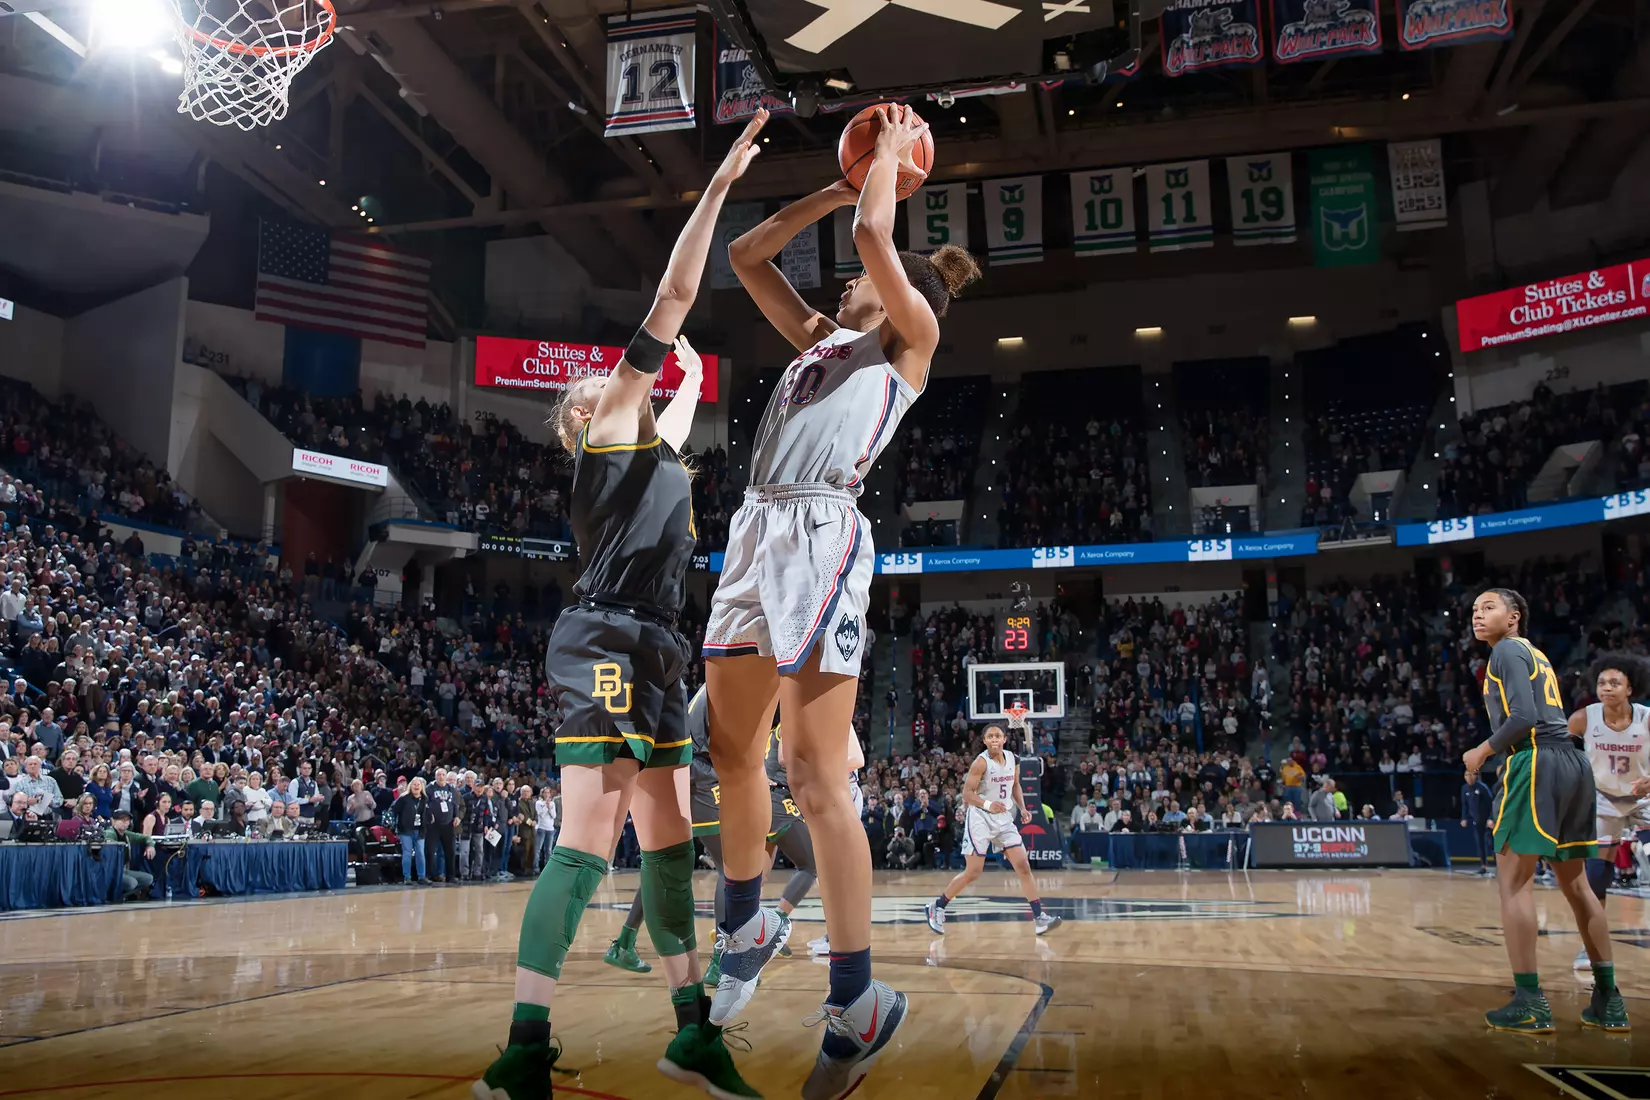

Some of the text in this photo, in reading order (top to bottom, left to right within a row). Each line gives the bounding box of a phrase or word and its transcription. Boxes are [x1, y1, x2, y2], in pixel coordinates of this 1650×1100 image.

[1326, 22, 1371, 46] PACK
[621, 59, 681, 105] 12
[1084, 198, 1124, 232] 10
[1161, 191, 1198, 226] 11
[1241, 187, 1286, 224] 19
[926, 214, 950, 246] 5
[1002, 207, 1025, 242] 9
[1524, 271, 1606, 303] Suites &
[1509, 289, 1627, 325] Club Tickets
[1481, 305, 1647, 347] PremiumSeating@XLCenter.com
[537, 341, 604, 362] Suites &
[522, 357, 560, 376] Club
[302, 453, 334, 466] RICOH
[350, 463, 380, 476] RICOH
[1507, 514, 1543, 527] Company
[552, 543, 562, 554] 0
[1104, 549, 1134, 560] Company
[1263, 541, 1295, 551] Company
[692, 555, 708, 564] 7:03
[694, 562, 706, 570] PM
[952, 556, 980, 566] Company
[1006, 617, 1030, 628] 9:29
[1004, 630, 1028, 650] 23
[591, 663, 634, 713] BU
[1608, 754, 1630, 775] 13
[999, 784, 1007, 799] 5
[1292, 826, 1366, 842] UCONN
